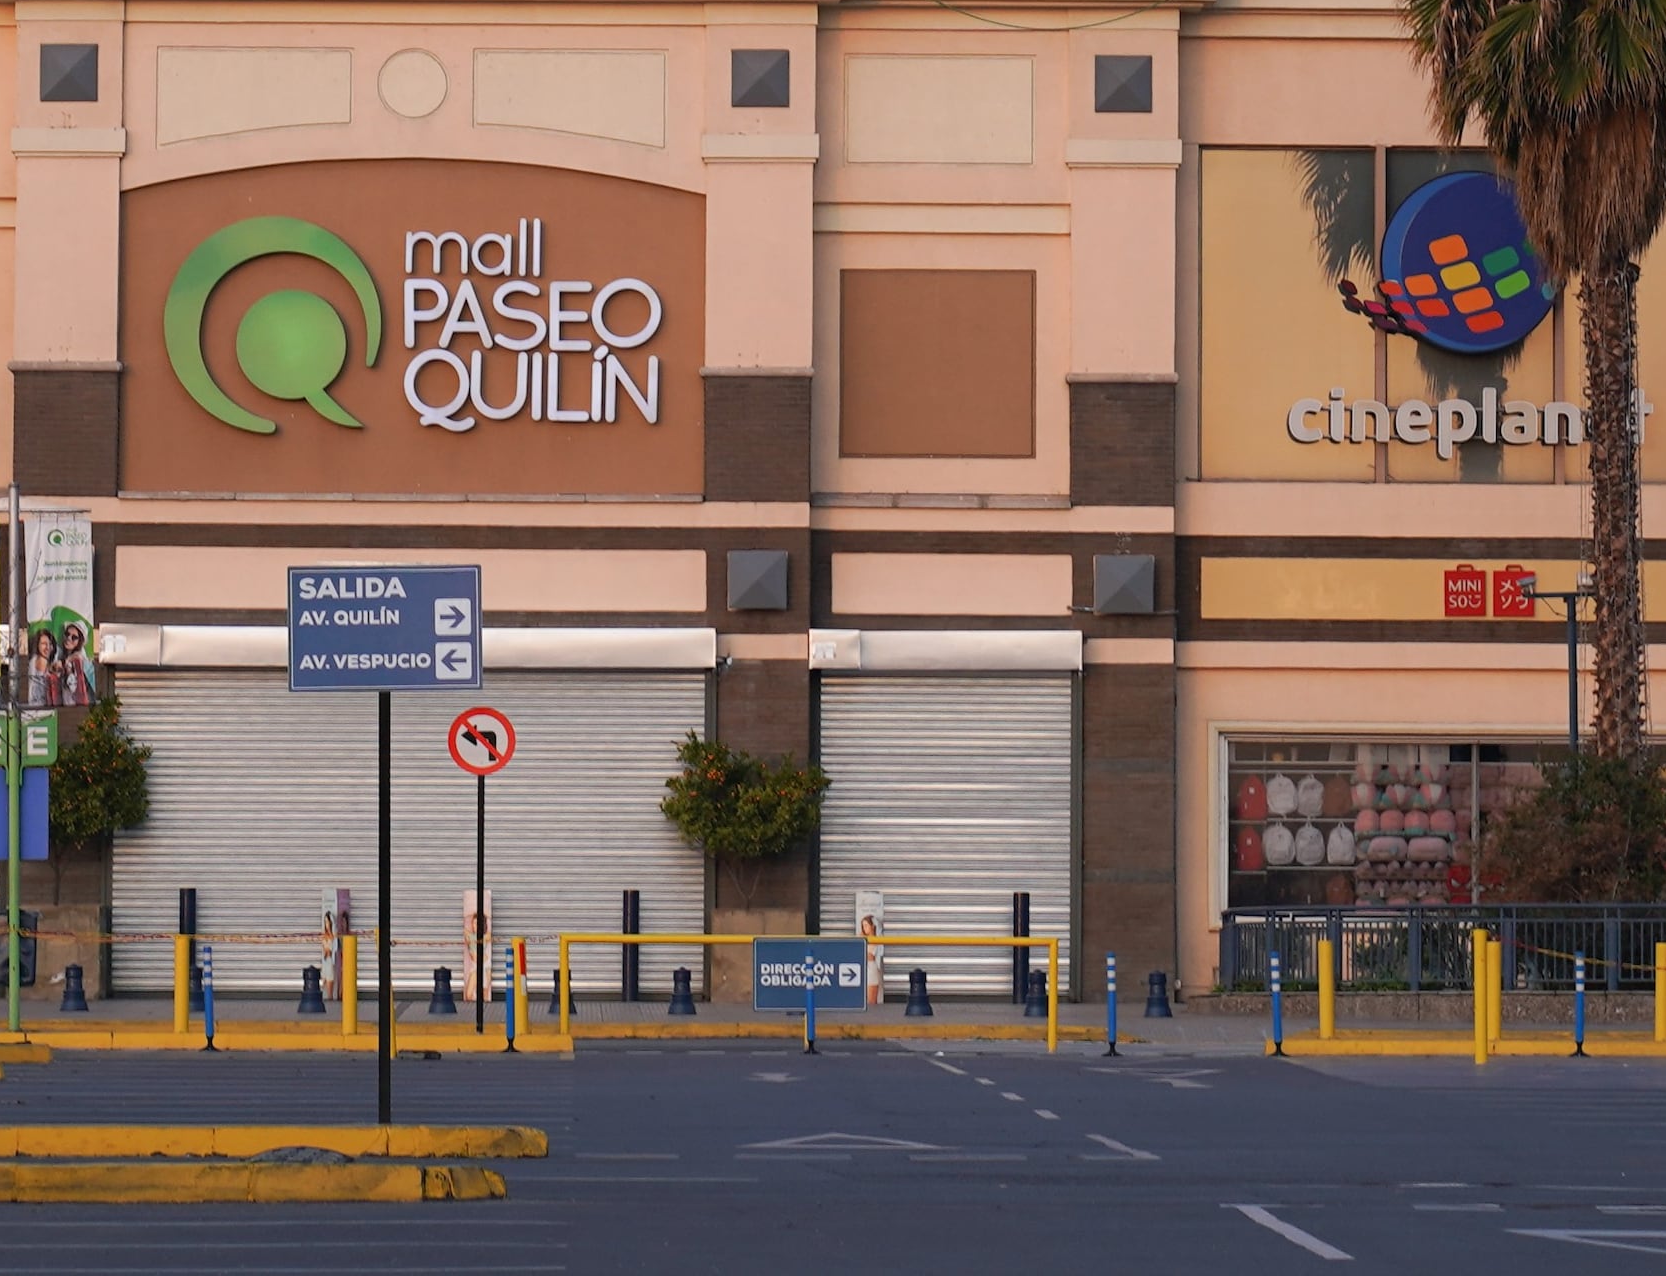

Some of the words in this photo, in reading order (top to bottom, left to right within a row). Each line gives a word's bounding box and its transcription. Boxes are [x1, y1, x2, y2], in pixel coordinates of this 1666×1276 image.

[404, 217, 541, 278] mall
[403, 277, 662, 353] PASEO
[403, 344, 660, 432] QUILÍN
[1287, 386, 1653, 460] cineplant
[299, 576, 407, 600] SALIDA
[1448, 579, 1481, 592] MINI
[299, 610, 330, 626] AV.
[333, 606, 400, 625] QUILÍN
[299, 654, 331, 670] AV.
[333, 653, 432, 669] VESPUCIO
[27, 726, 48, 756] E
[761, 960, 834, 975] DIRECCÓN
